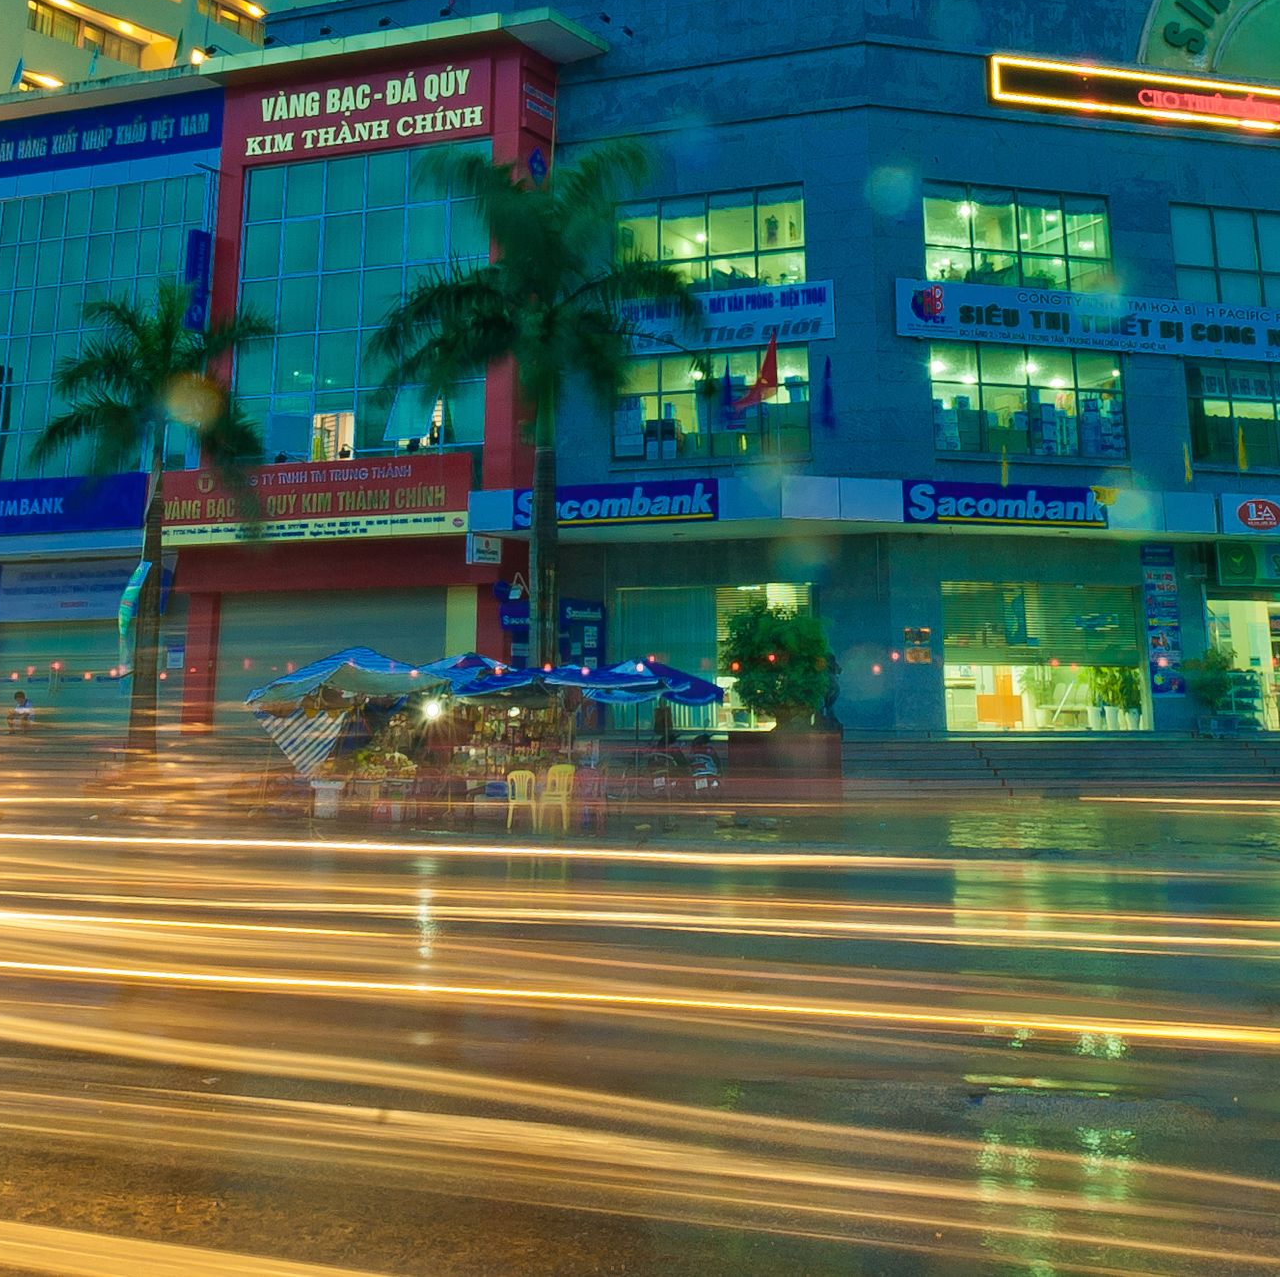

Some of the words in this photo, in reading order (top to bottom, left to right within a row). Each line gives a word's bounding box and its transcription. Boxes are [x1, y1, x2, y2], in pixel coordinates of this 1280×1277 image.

[326, 84, 371, 117] BẠC
[386, 71, 418, 106] ĐÁ
[180, 113, 210, 137] NAM
[245, 132, 295, 156] KIM
[301, 120, 390, 149] THÀNH
[396, 105, 484, 137] CHÍNH
[1219, 309, 1271, 323] PACIFIC
[329, 466, 369, 482] TRUNG
[301, 491, 332, 515] KIM
[336, 485, 390, 512] THÀNH
[394, 481, 447, 509] CHÍNH
[514, 482, 713, 527] Scombank
[909, 483, 1105, 521] Sacombank
